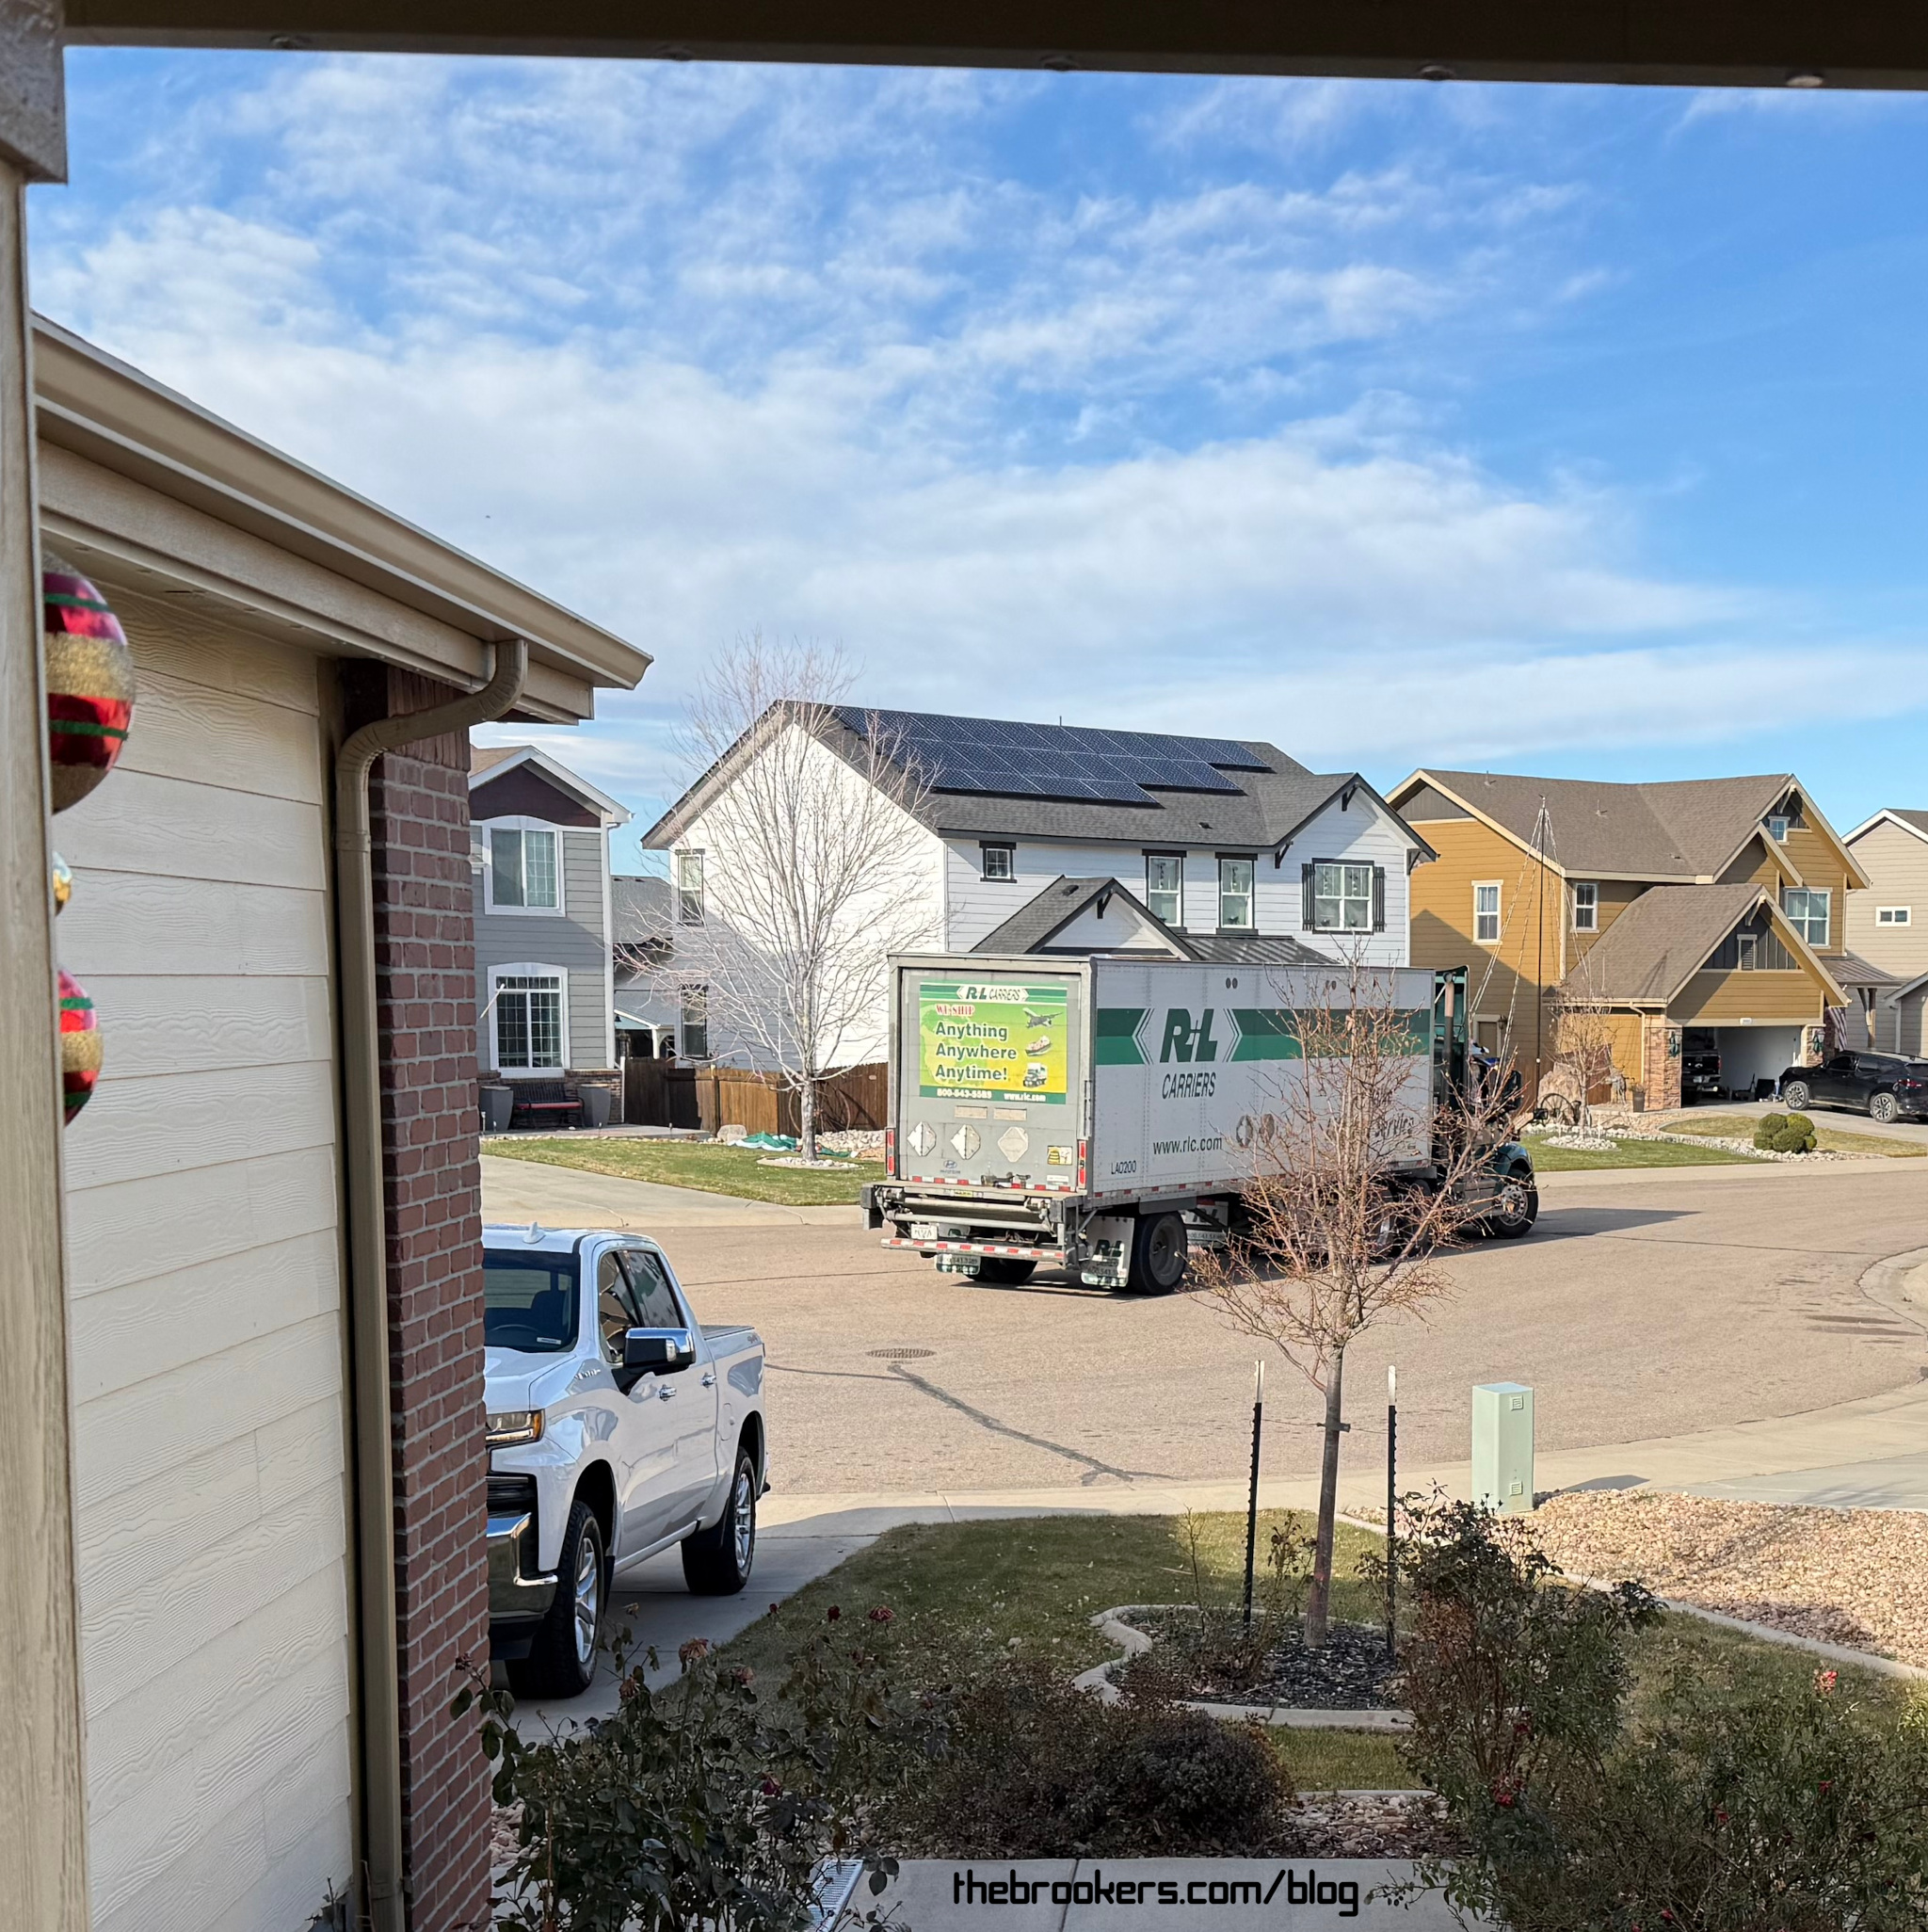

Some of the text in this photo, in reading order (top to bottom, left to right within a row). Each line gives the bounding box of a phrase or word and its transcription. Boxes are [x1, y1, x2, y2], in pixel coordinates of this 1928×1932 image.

[936, 1022, 1007, 1040] Anything
[936, 1042, 1017, 1060] Anywhere
[936, 1064, 1007, 1082] Anytime!
[1162, 1071, 1216, 1100] CARRIERS
[1152, 1135, 1223, 1155] www.rlc.com
